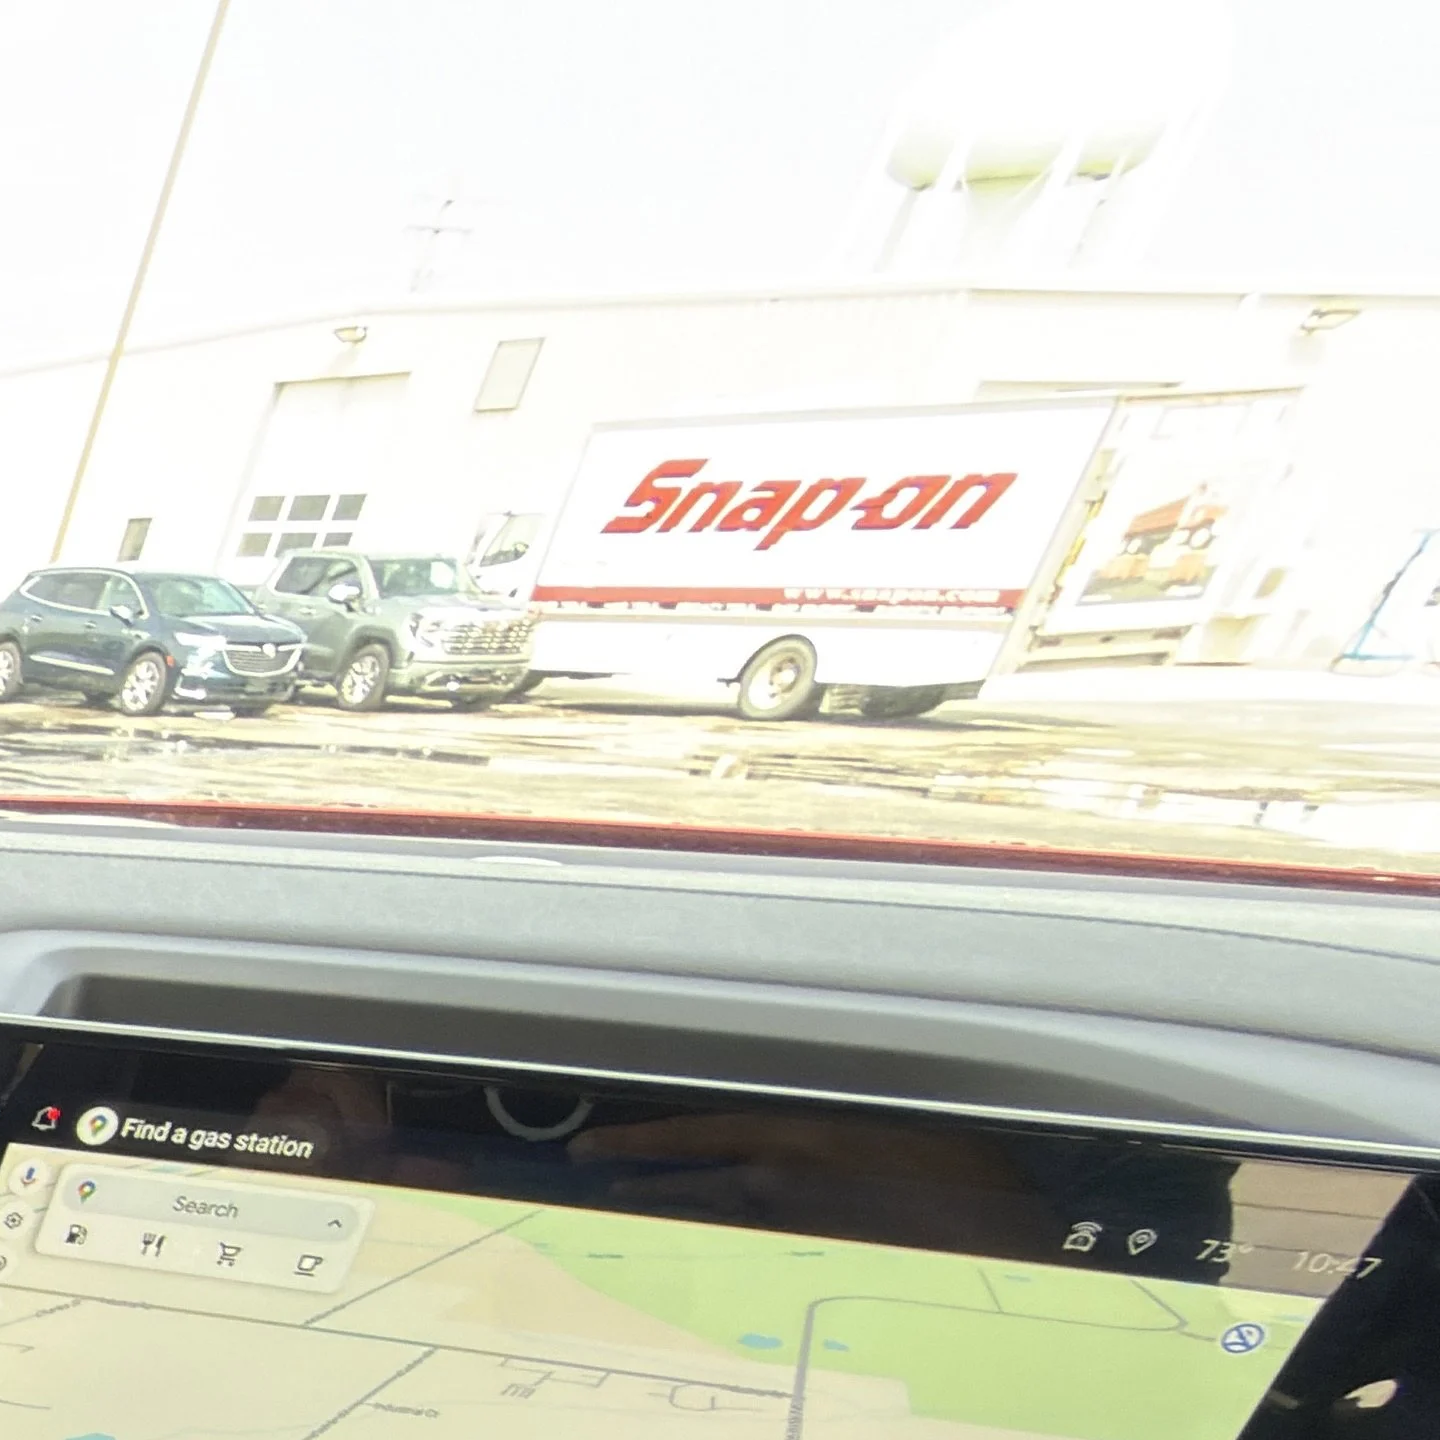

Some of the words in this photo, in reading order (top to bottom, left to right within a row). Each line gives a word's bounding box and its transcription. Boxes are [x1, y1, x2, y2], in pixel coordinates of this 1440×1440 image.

[600, 458, 1018, 551] Snap-on
[120, 1117, 172, 1143] Find
[170, 1127, 188, 1145] a
[187, 1128, 232, 1151] gas
[232, 1132, 314, 1160] station
[172, 1195, 240, 1219] Search
